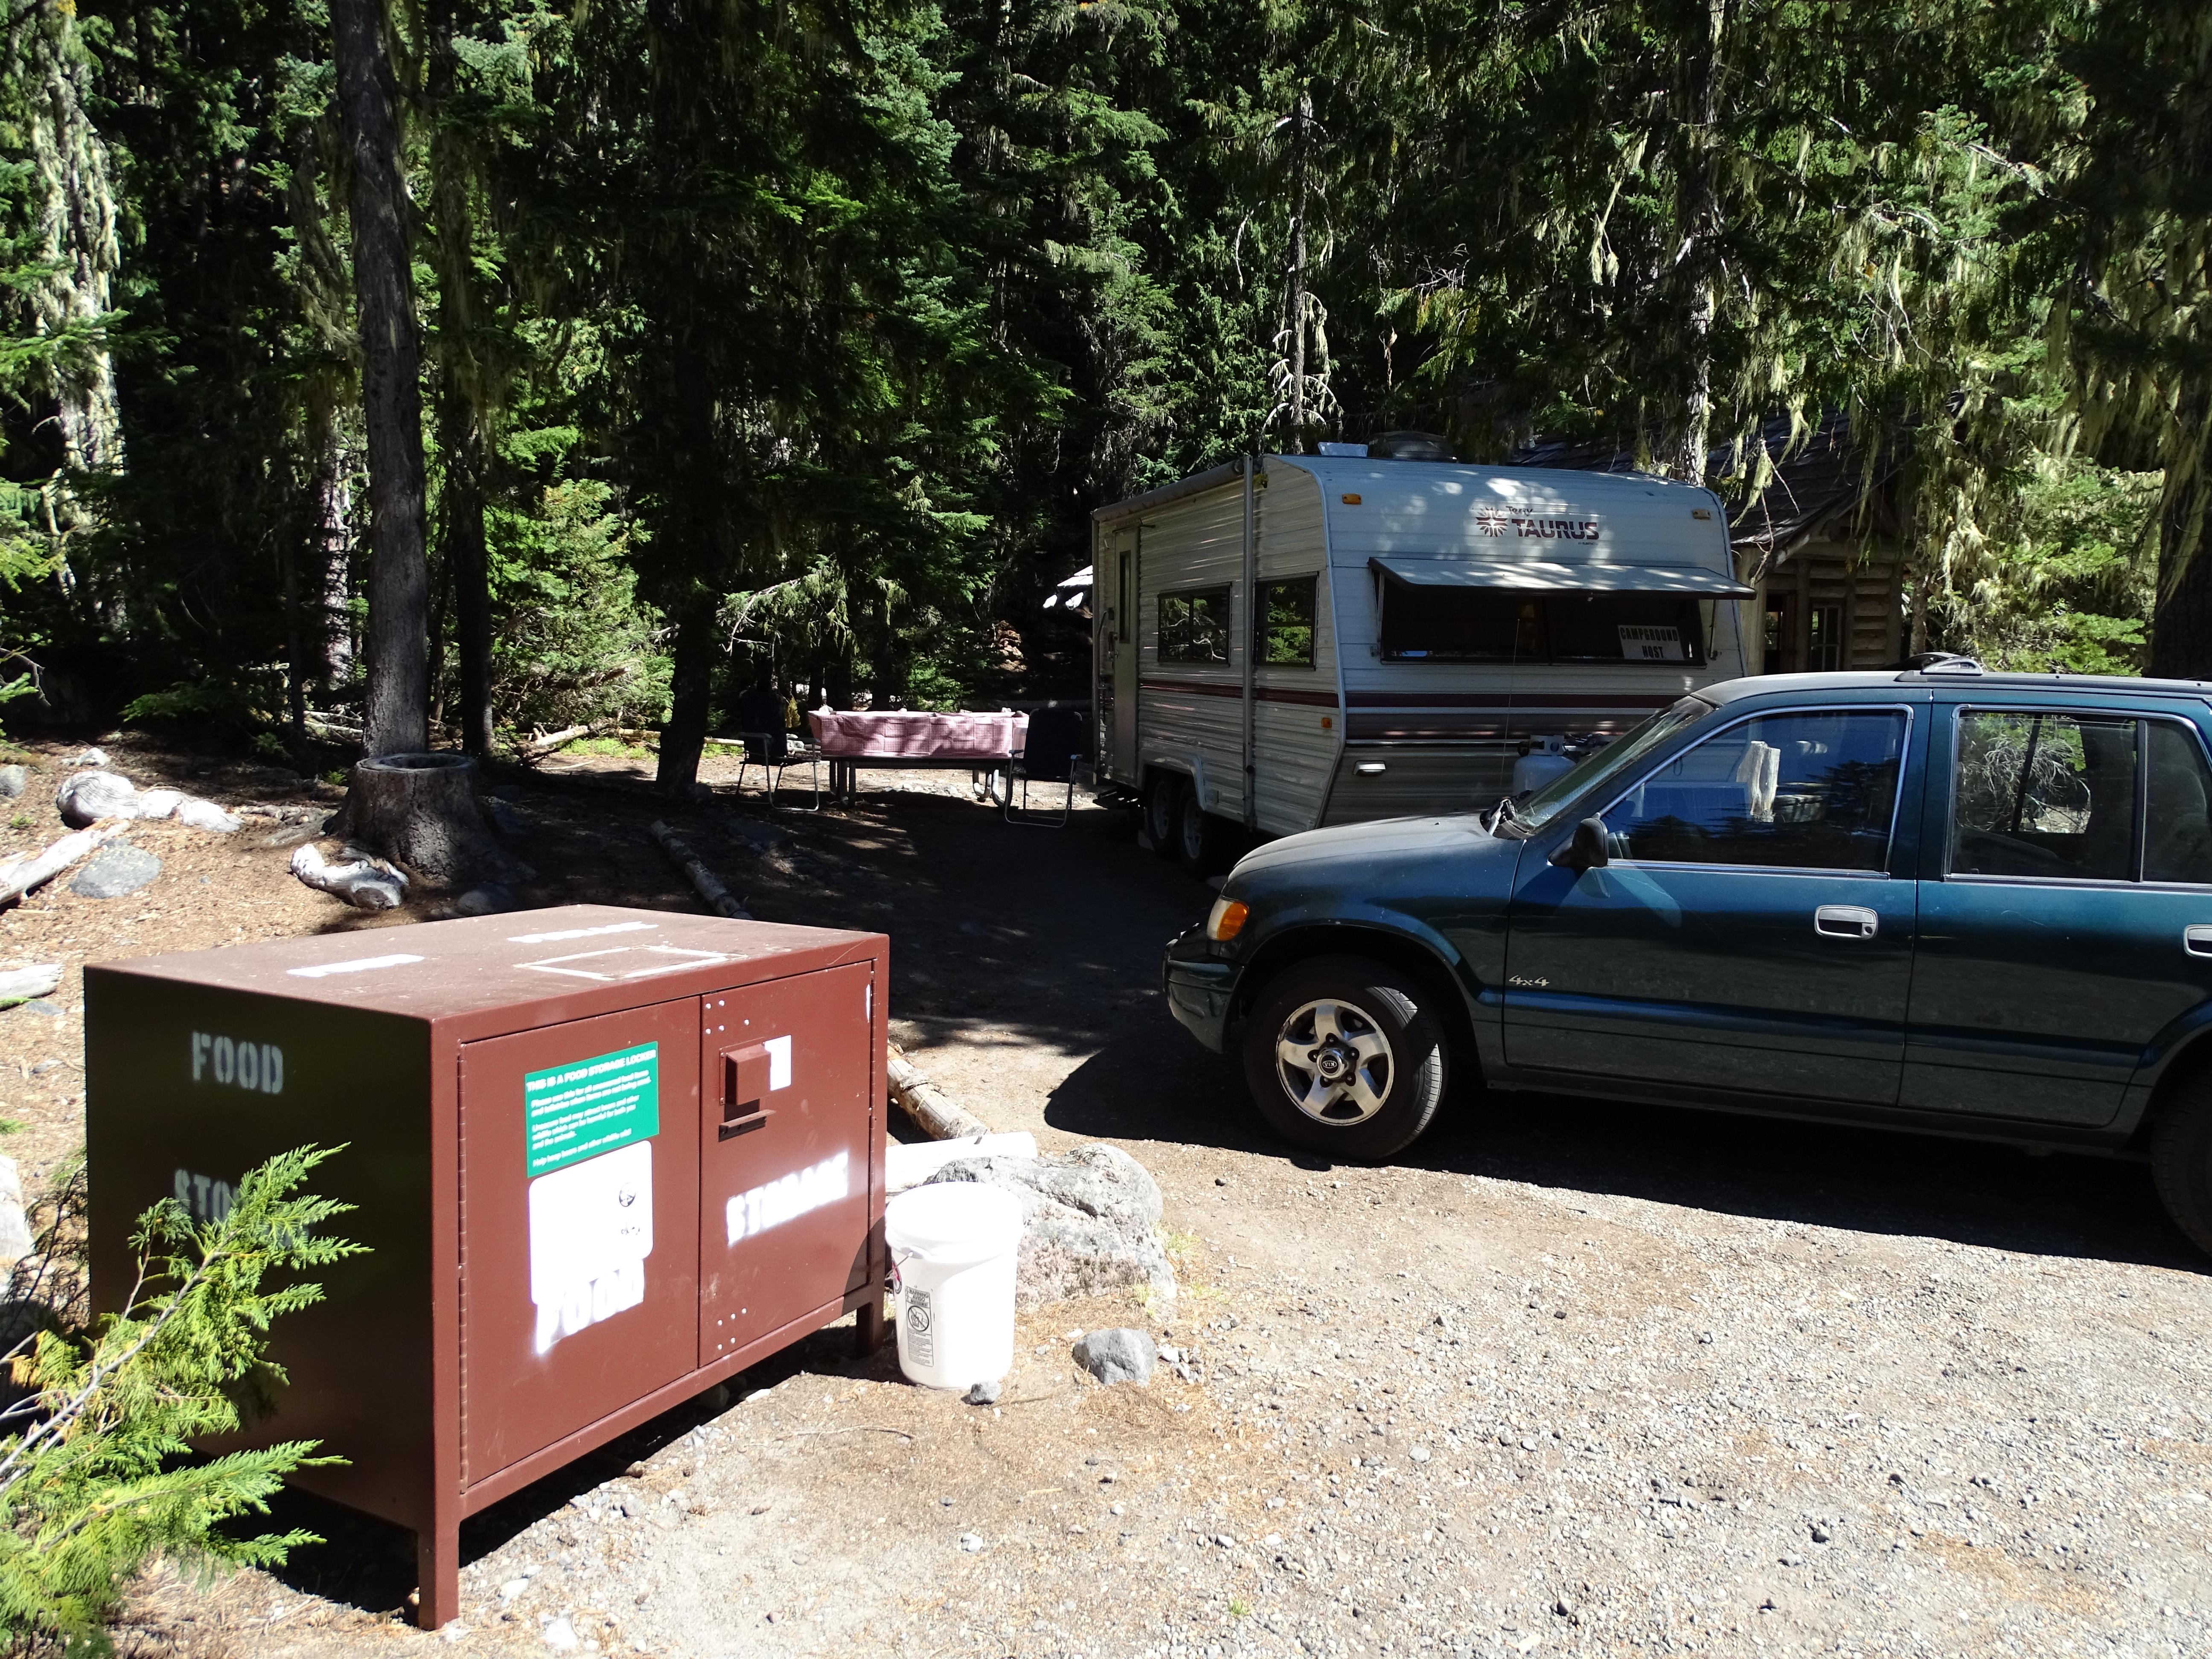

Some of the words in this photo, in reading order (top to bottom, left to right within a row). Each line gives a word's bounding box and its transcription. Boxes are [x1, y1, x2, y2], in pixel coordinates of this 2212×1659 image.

[1506, 506, 1533, 516] Terry
[1511, 519, 1599, 540] TAURUS
[1620, 627, 1679, 641] CAMPGROUND
[1642, 645, 1664, 658] HOST
[1509, 975, 1550, 987] 4x4
[192, 1031, 283, 1094] FOOD
